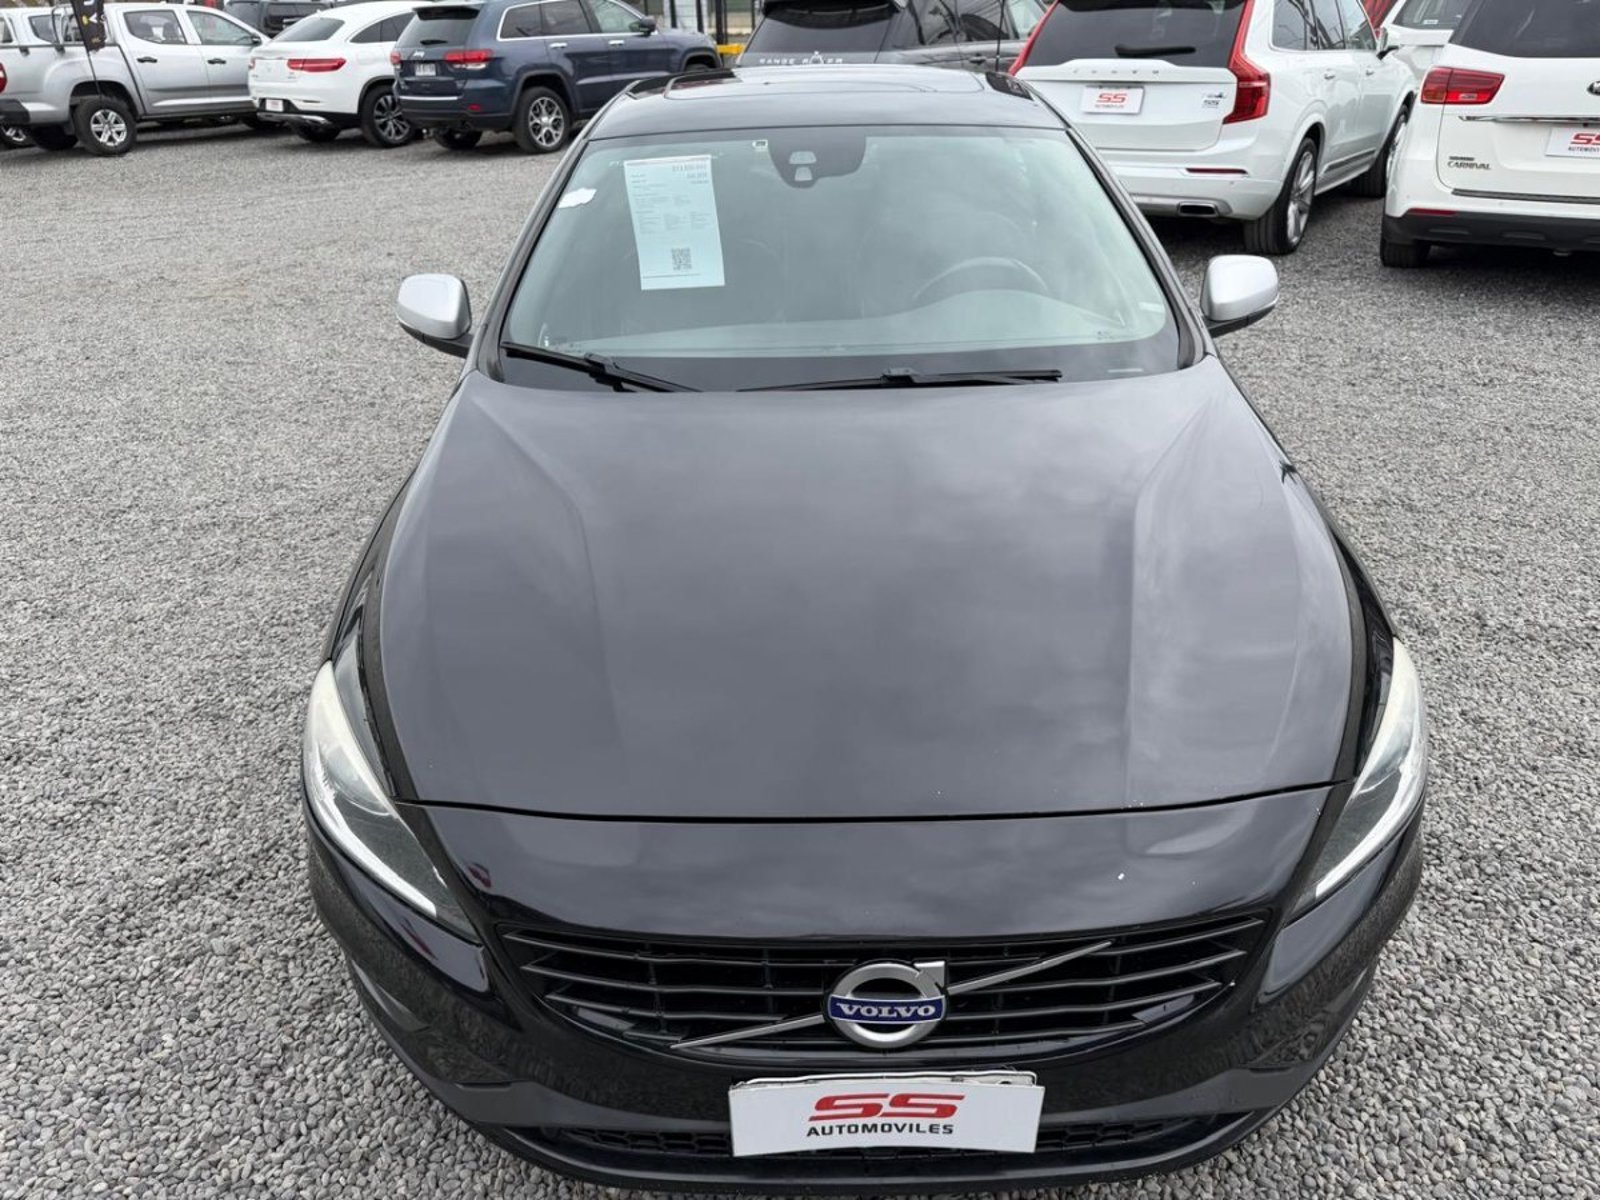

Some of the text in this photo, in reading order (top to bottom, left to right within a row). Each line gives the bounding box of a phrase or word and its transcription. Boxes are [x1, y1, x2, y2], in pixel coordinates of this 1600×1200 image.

[1096, 92, 1128, 103] SS
[1447, 160, 1492, 170] CARNIVAL
[835, 1002, 936, 1018] VOLVO
[808, 1092, 966, 1122] SS
[806, 1122, 954, 1138] AUTOMOVILES
